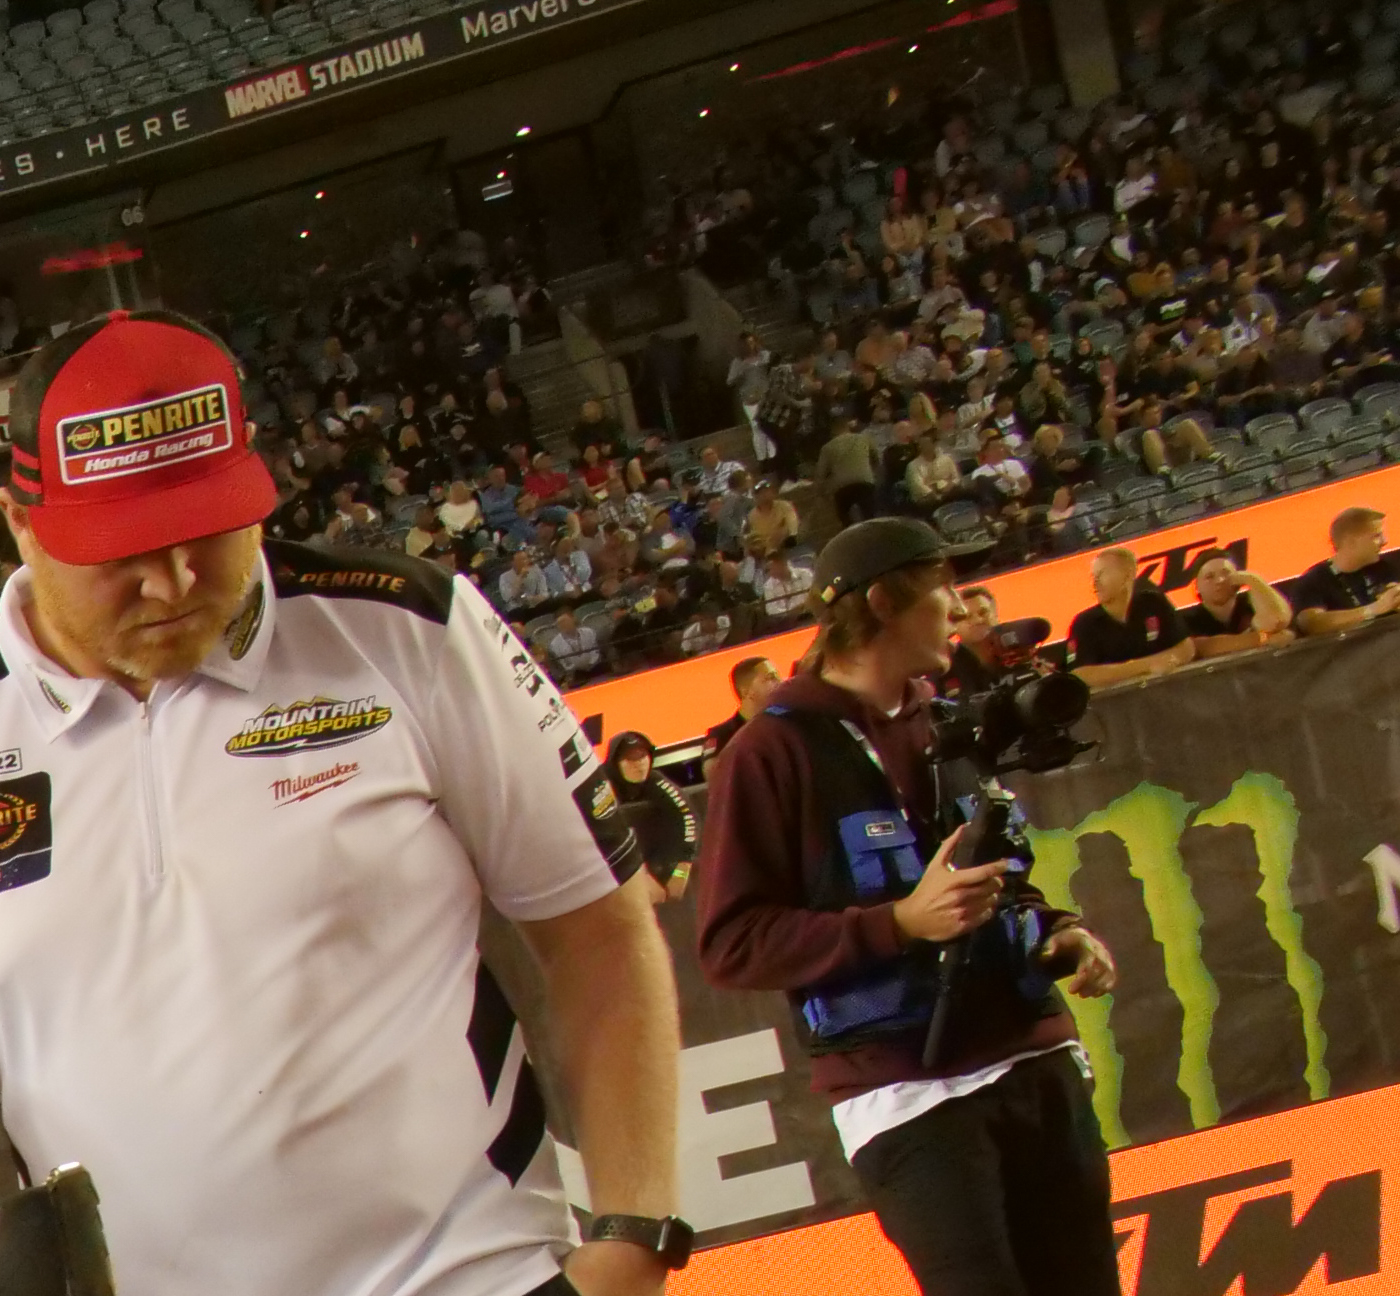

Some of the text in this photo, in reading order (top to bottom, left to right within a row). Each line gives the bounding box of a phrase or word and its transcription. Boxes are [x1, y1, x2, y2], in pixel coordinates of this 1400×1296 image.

[225, 32, 425, 118] MARVEL STADIUM
[85, 107, 190, 157] HERE
[102, 391, 221, 446] PENRITE
[84, 448, 150, 473] Honda
[300, 570, 407, 594] PENRITE
[228, 706, 393, 752] MOTORSPORTS
[242, 695, 377, 734] MOUNTAIN
[273, 761, 362, 801] Milwaukee
